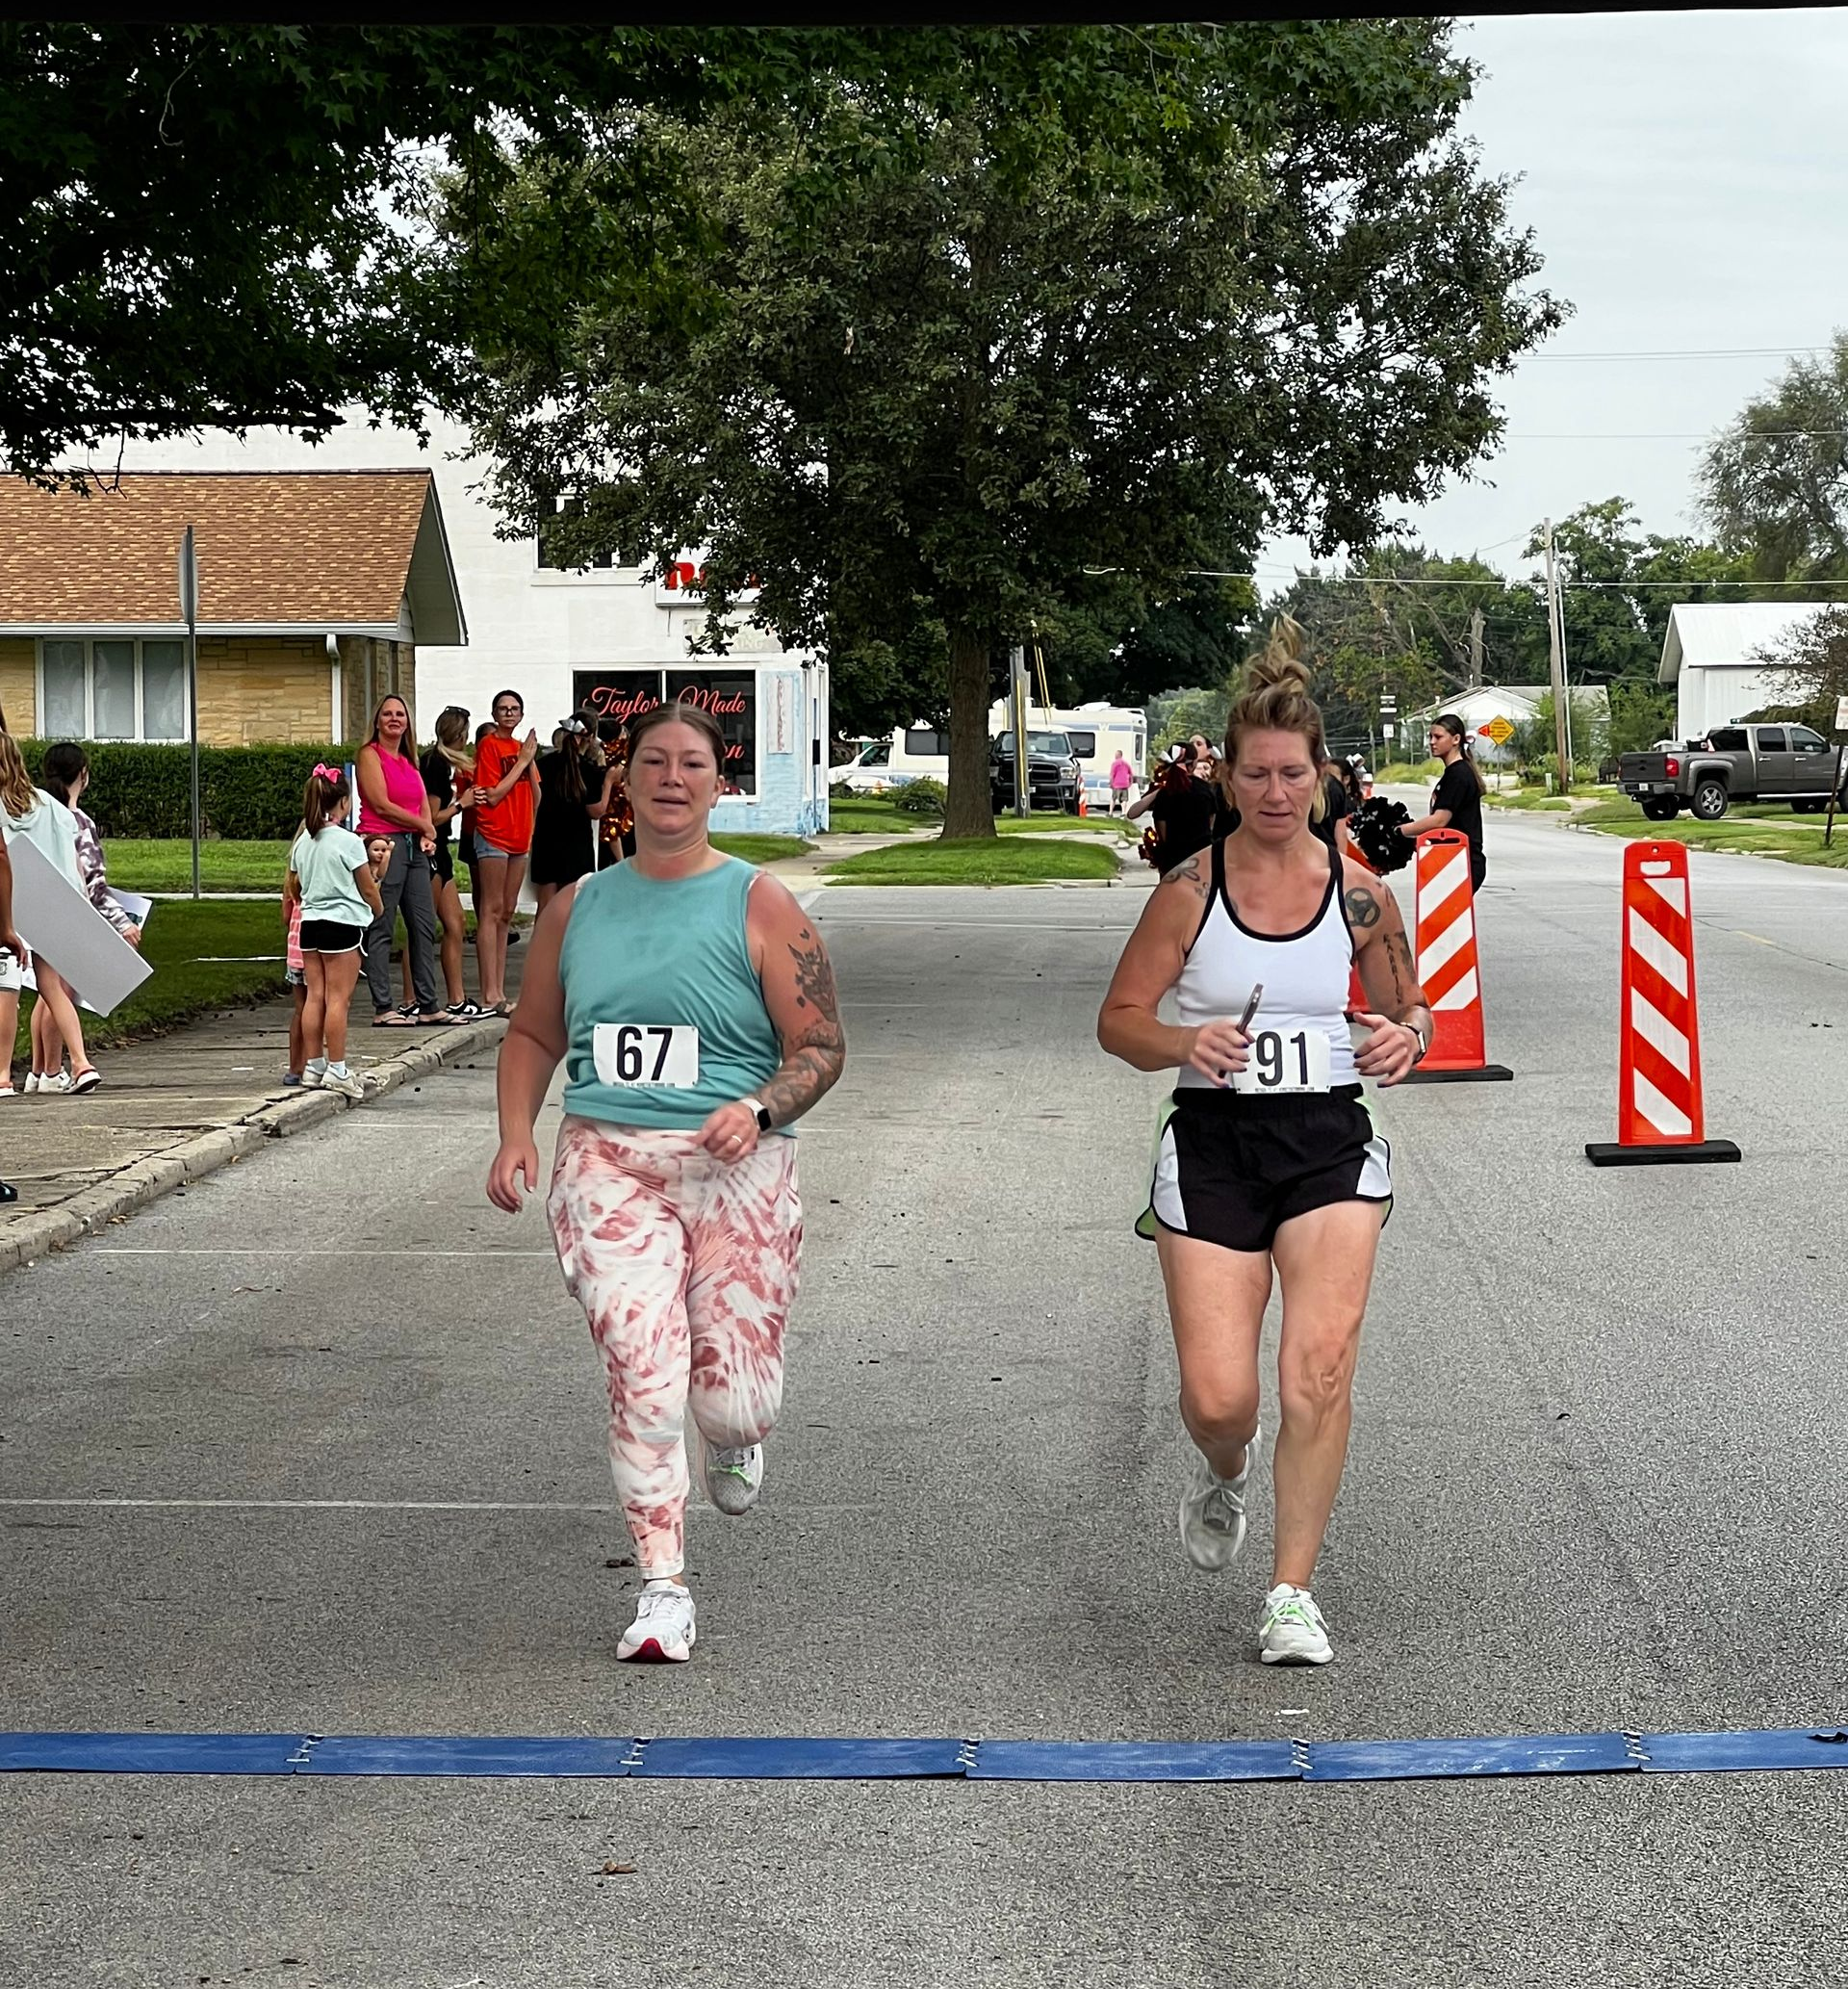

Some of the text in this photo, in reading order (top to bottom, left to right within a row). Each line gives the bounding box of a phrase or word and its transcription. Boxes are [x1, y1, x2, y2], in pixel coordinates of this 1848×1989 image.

[582, 686, 659, 724] Taylor
[678, 685, 747, 717] Made
[616, 1025, 673, 1081] 67
[1255, 1030, 1309, 1087] 91
